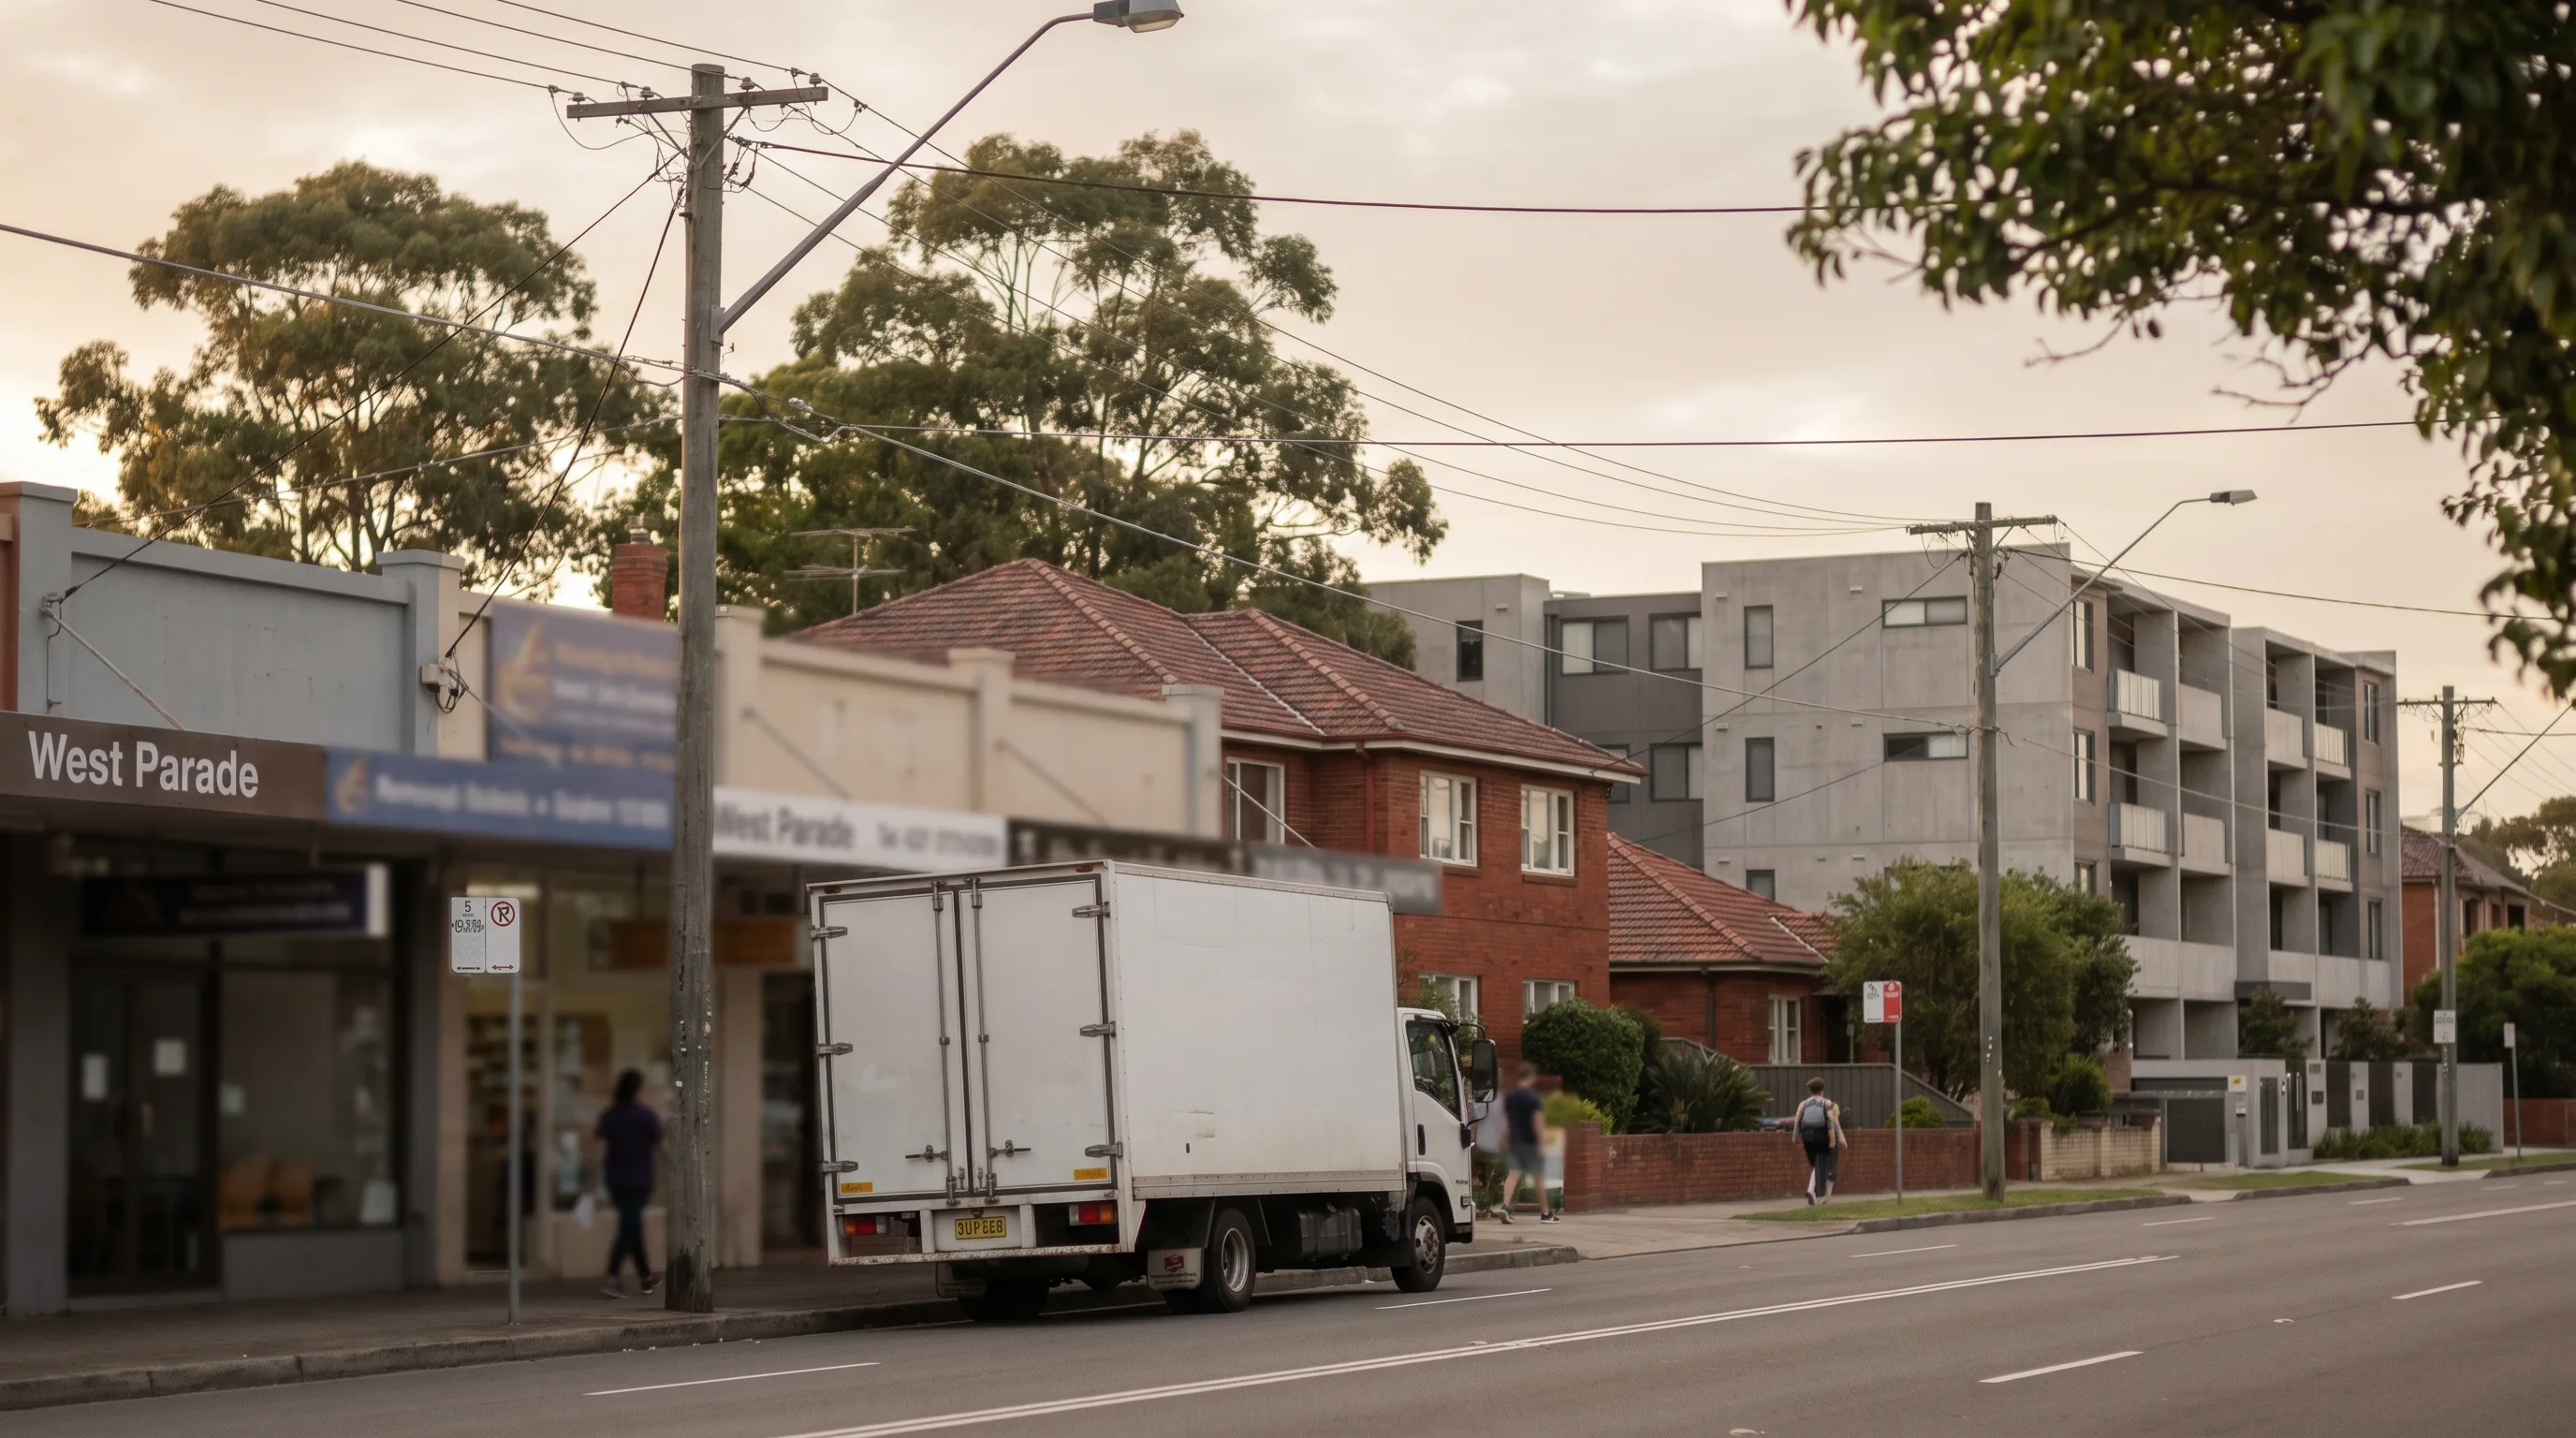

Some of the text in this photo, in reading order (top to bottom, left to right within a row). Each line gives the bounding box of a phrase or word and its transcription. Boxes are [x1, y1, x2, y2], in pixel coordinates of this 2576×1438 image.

[28, 730, 259, 798] West Parade
[464, 901, 472, 913] 5
